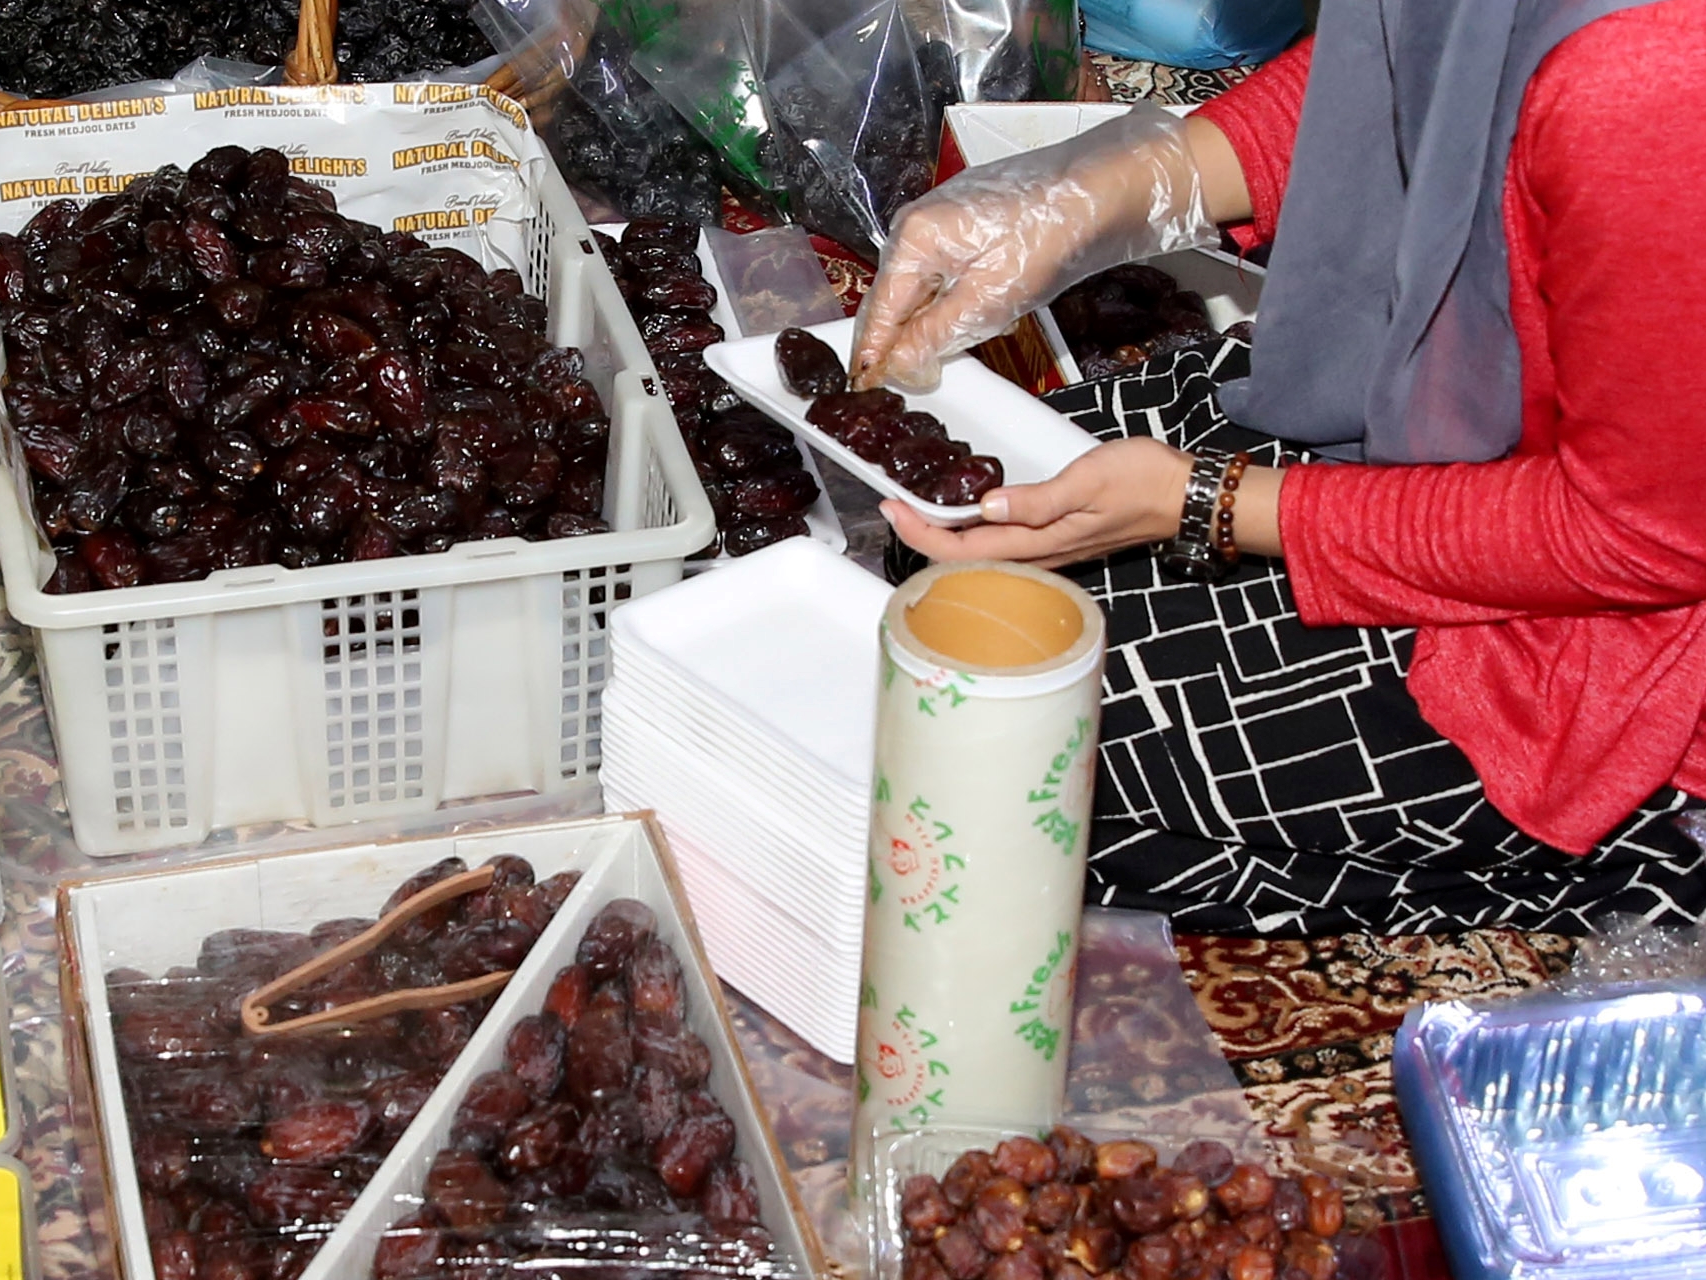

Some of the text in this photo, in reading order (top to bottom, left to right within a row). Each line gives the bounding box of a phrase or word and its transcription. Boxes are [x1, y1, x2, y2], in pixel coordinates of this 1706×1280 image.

[194, 86, 274, 111] NATURAL
[394, 83, 473, 105] NATURAL
[77, 96, 167, 122] DELIGHTS
[224, 109, 255, 119] FRESH
[256, 108, 302, 118] MEDJOOL
[424, 105, 454, 115] FRESH
[24, 121, 137, 138] FRESH MEDJOOL DATES
[392, 141, 468, 171] NATURAL
[421, 163, 450, 175] FRESH
[0, 177, 81, 202] NATURAL
[393, 208, 470, 233] NATURAL
[1027, 715, 1091, 804] Fresh
[1010, 929, 1073, 1015] Fresh
